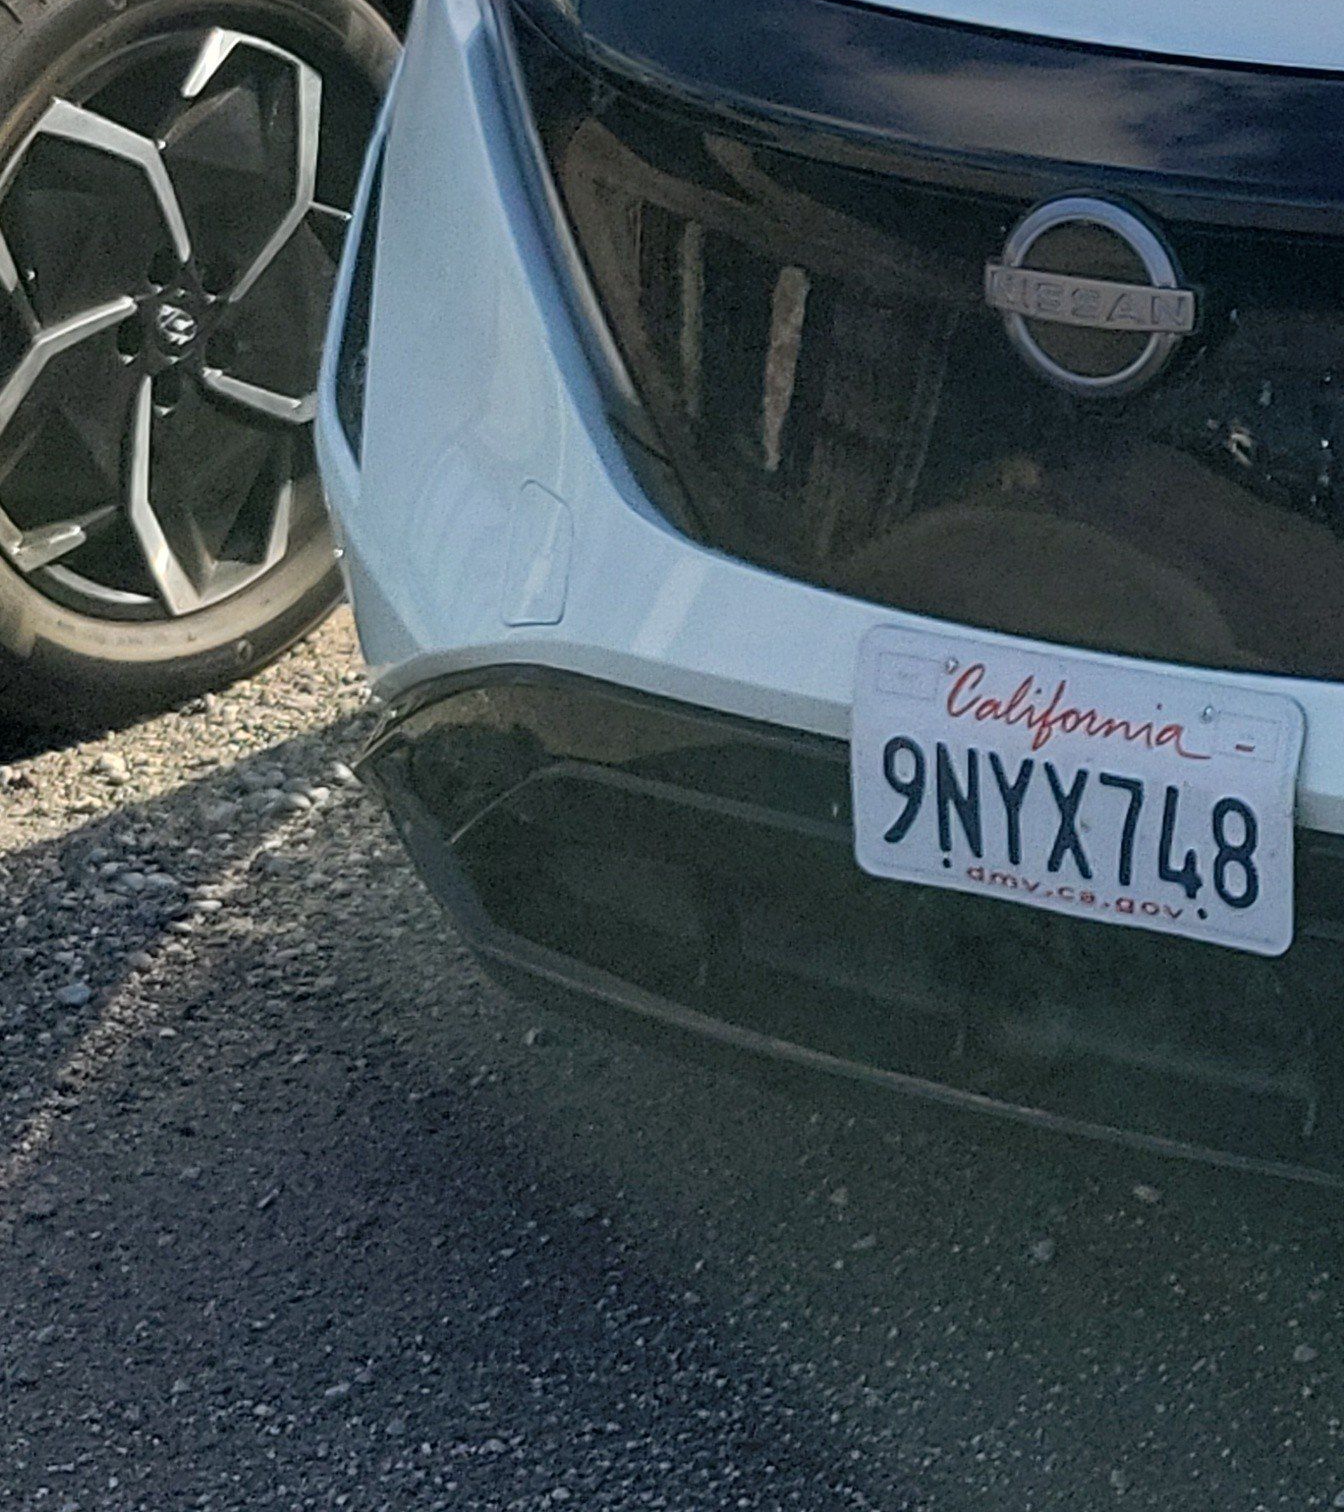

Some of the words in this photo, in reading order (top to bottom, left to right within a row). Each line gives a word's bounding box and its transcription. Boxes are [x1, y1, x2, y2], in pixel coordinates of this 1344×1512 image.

[988, 268, 1190, 328] NISSAN
[946, 663, 1212, 760] California
[883, 734, 1260, 909] 9NYX748
[966, 866, 1184, 920] dmv.ca.gov
